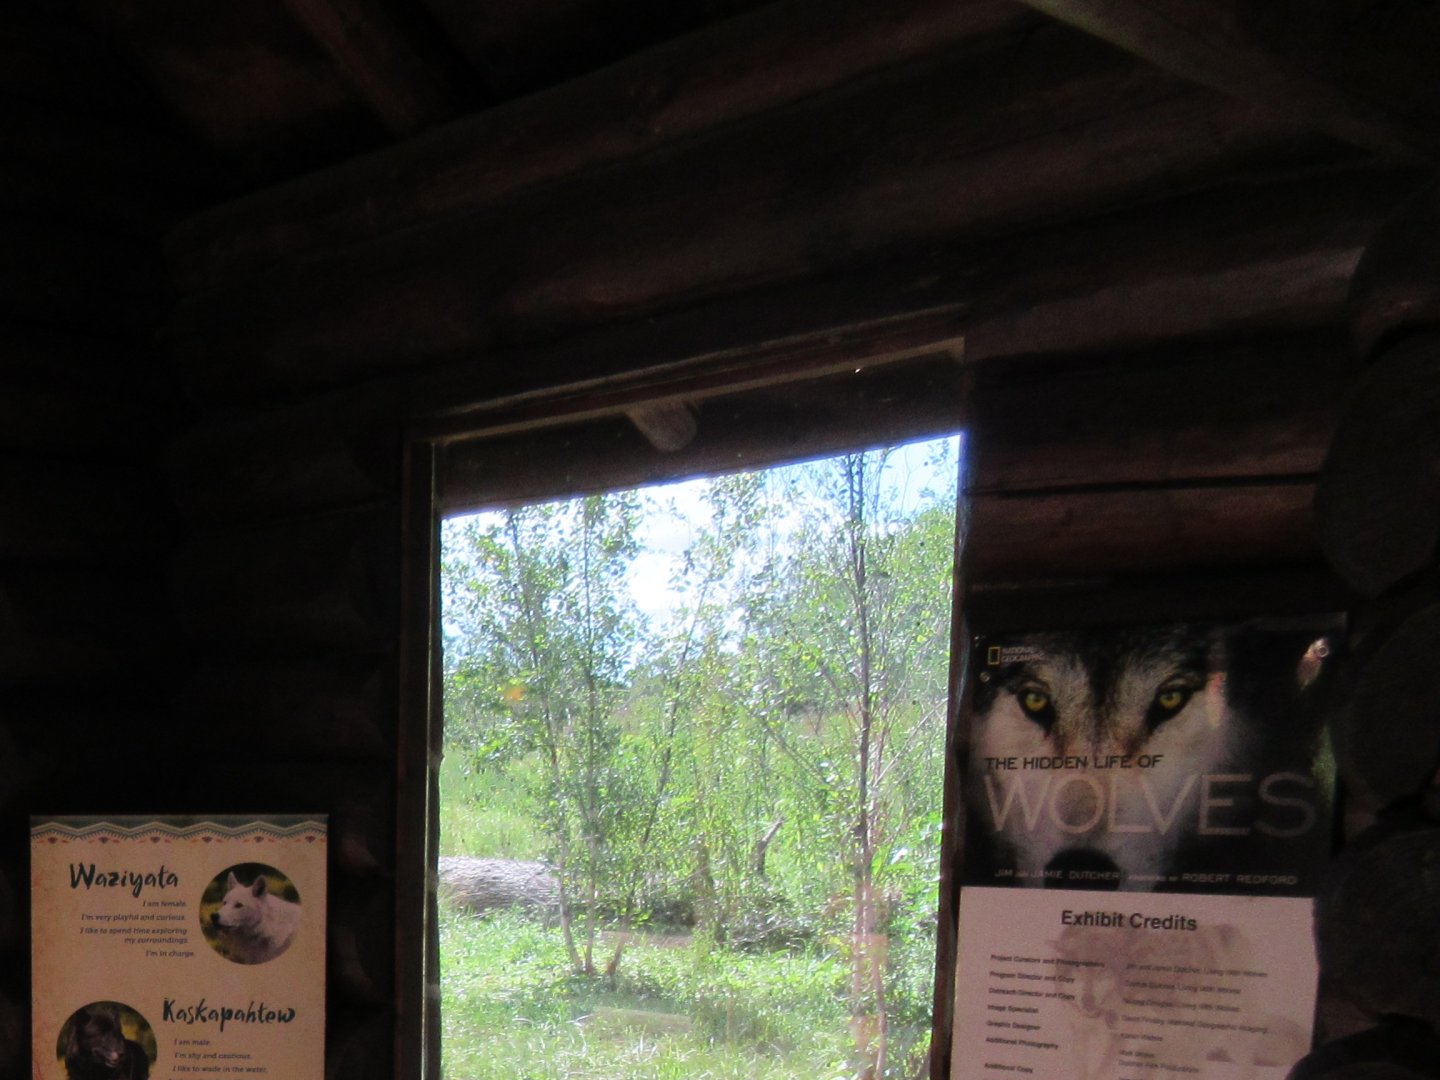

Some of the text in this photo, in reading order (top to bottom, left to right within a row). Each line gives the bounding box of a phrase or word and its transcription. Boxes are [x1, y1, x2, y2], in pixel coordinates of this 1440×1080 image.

[985, 754, 1164, 770] THE HIDDEN LIFE OF
[984, 770, 1318, 837] WOLVES
[69, 862, 179, 898] Waziyata
[995, 868, 1013, 878] JIM
[1031, 870, 1063, 879] JAMIE
[1069, 870, 1121, 881] DUTCHER
[1182, 872, 1231, 883] ROBERT
[1236, 874, 1299, 885] REDFORD
[1061, 910, 1198, 931] Exhibit Credits
[163, 997, 296, 1032] Kaskapahtew
